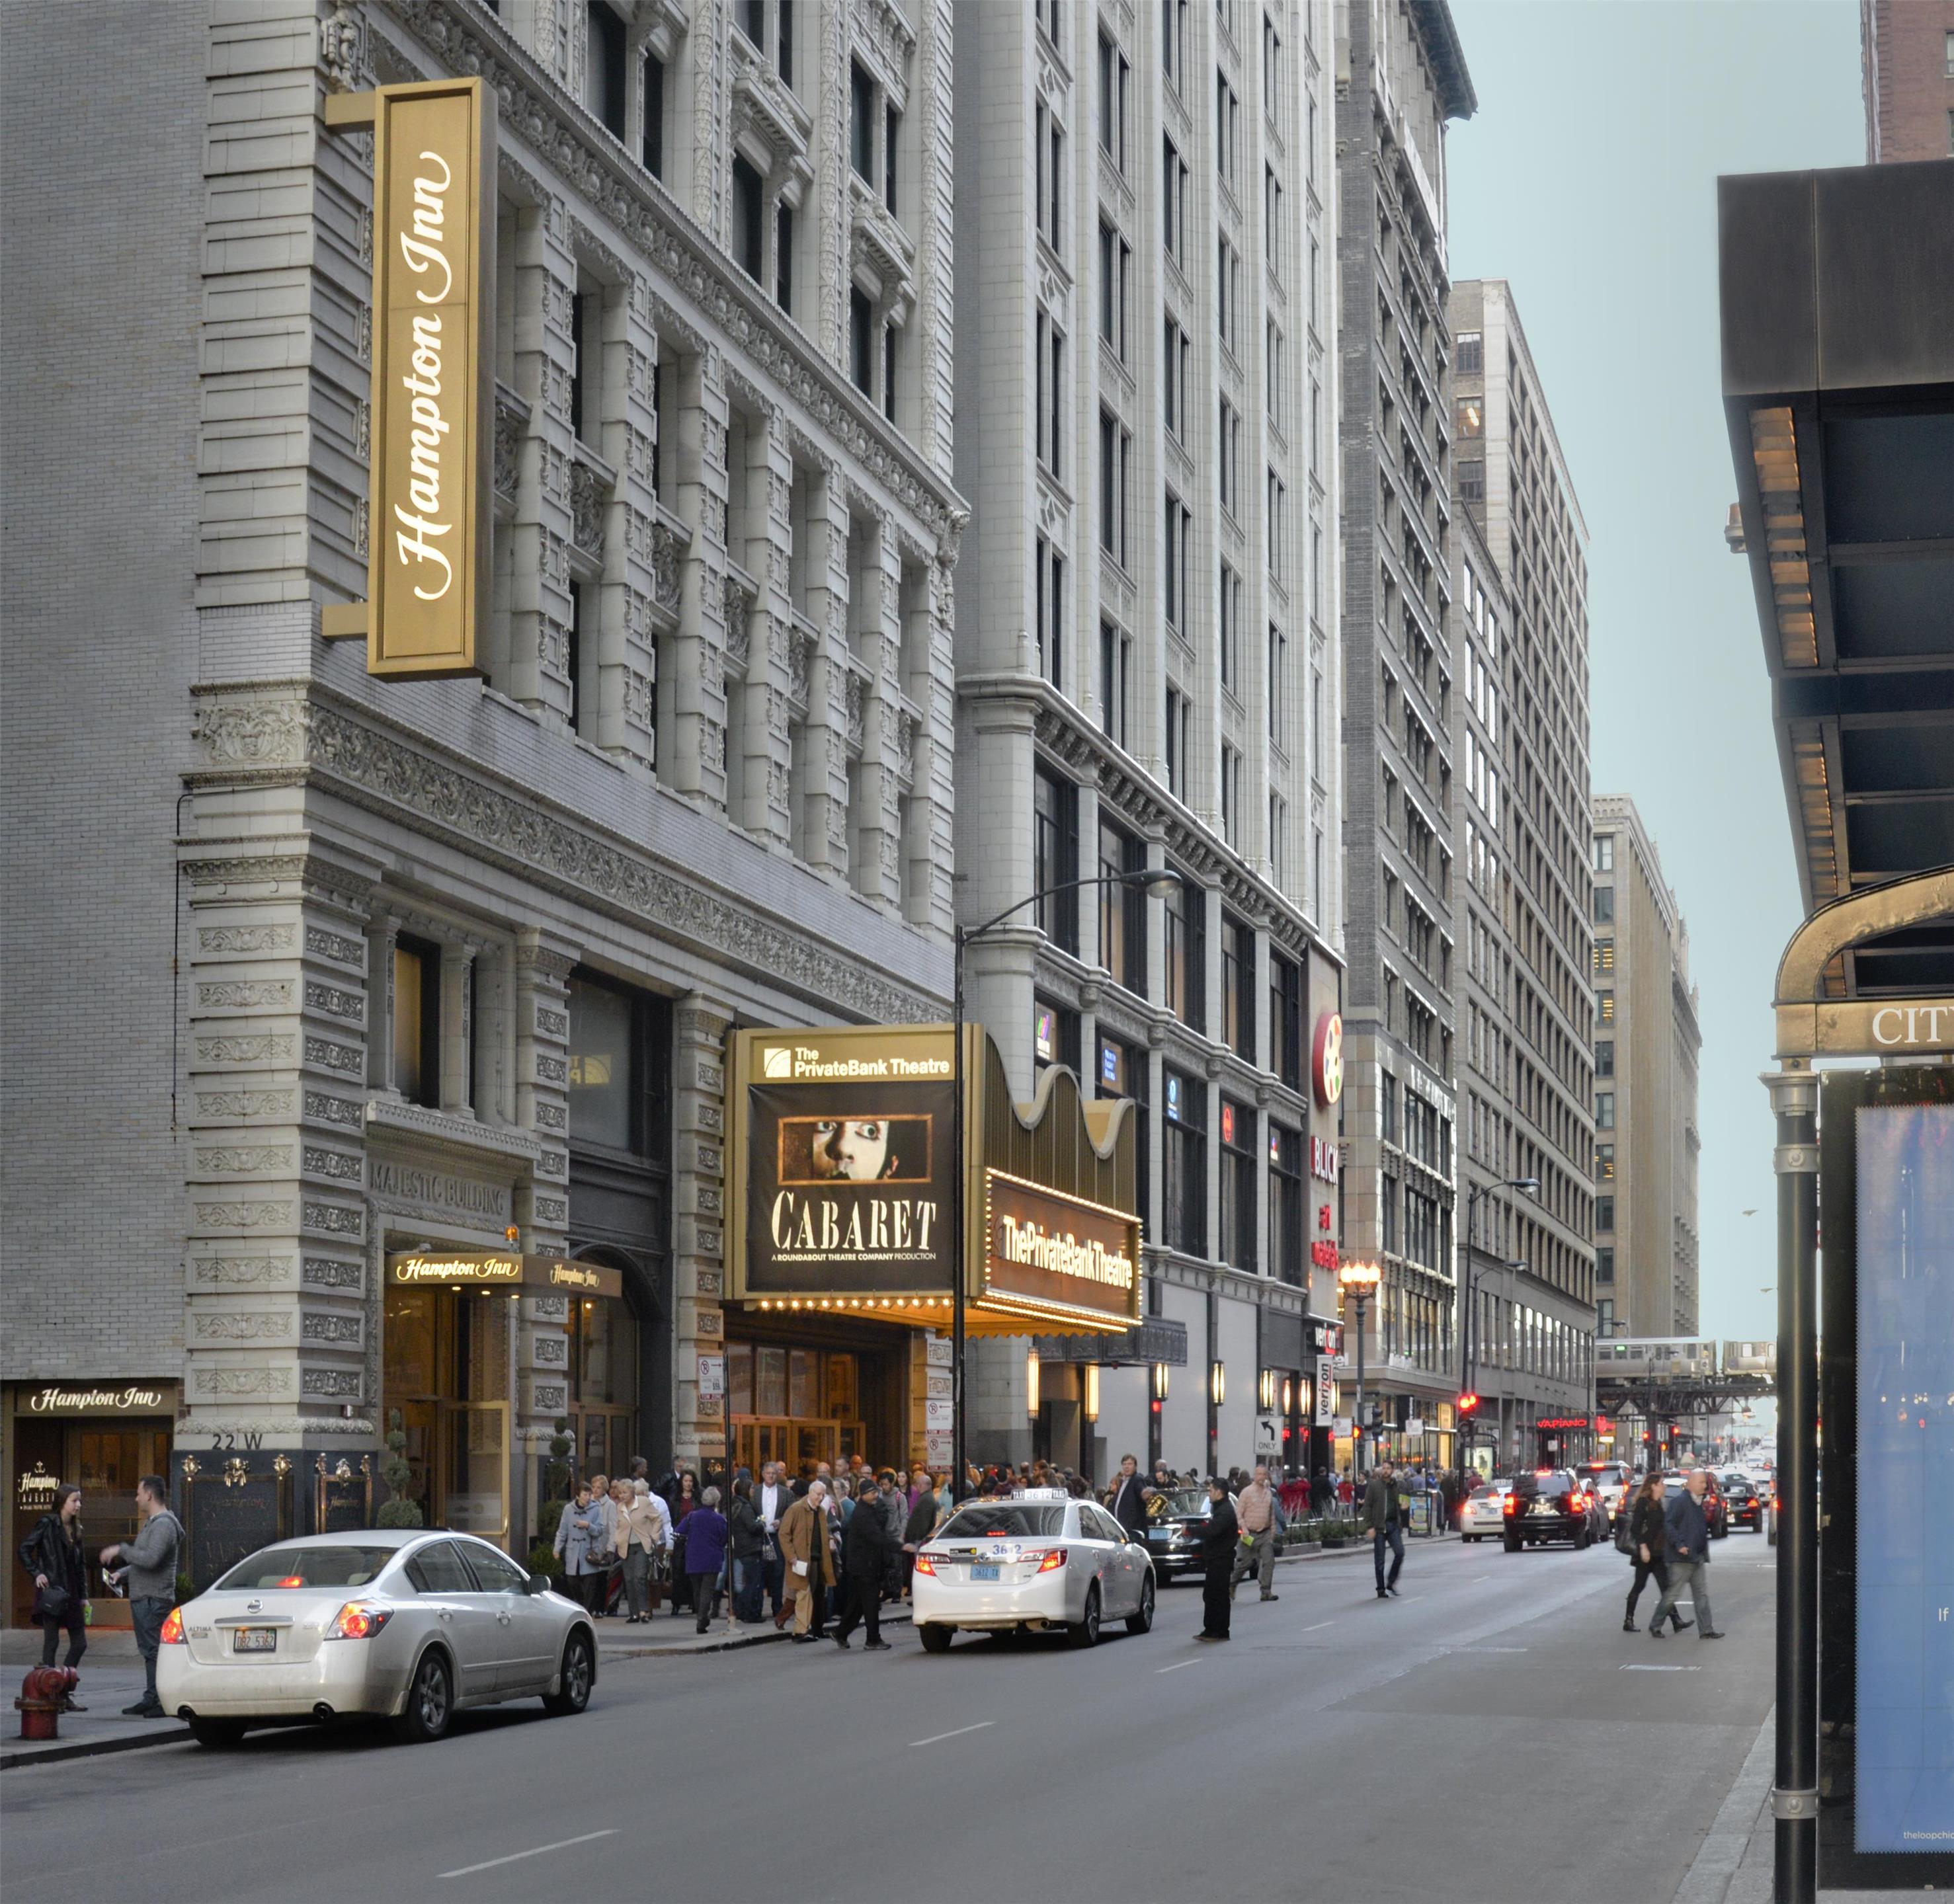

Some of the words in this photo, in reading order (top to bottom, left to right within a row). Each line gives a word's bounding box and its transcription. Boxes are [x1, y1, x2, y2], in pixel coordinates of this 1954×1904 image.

[399, 150, 453, 305] Inn
[393, 313, 452, 600] Hampton
[1873, 1006, 1954, 1045] CIT
[795, 1047, 819, 1060] The
[795, 1060, 888, 1077] PrivateBank
[890, 1058, 950, 1075] Theatre
[1312, 1136, 1338, 1185] BLICK
[370, 1162, 442, 1204] MAJESTIC
[445, 1178, 504, 1216] BUILDING
[772, 1190, 936, 1251] CABARET
[397, 1258, 476, 1280] Hampton
[475, 1258, 518, 1277] Inn
[550, 1263, 583, 1287] Hampton
[582, 1270, 599, 1288] Inn
[31, 1388, 115, 1411] Hampton
[116, 1388, 161, 1408] Inn
[1319, 1363, 1332, 1415] verizon
[212, 1434, 235, 1450] 22
[245, 1434, 263, 1450] W
[19, 1473, 60, 1493] Hampton
[1012, 1489, 1025, 1500] TAXI
[1053, 1489, 1065, 1499] TAXI
[1938, 1607, 1949, 1622] If
